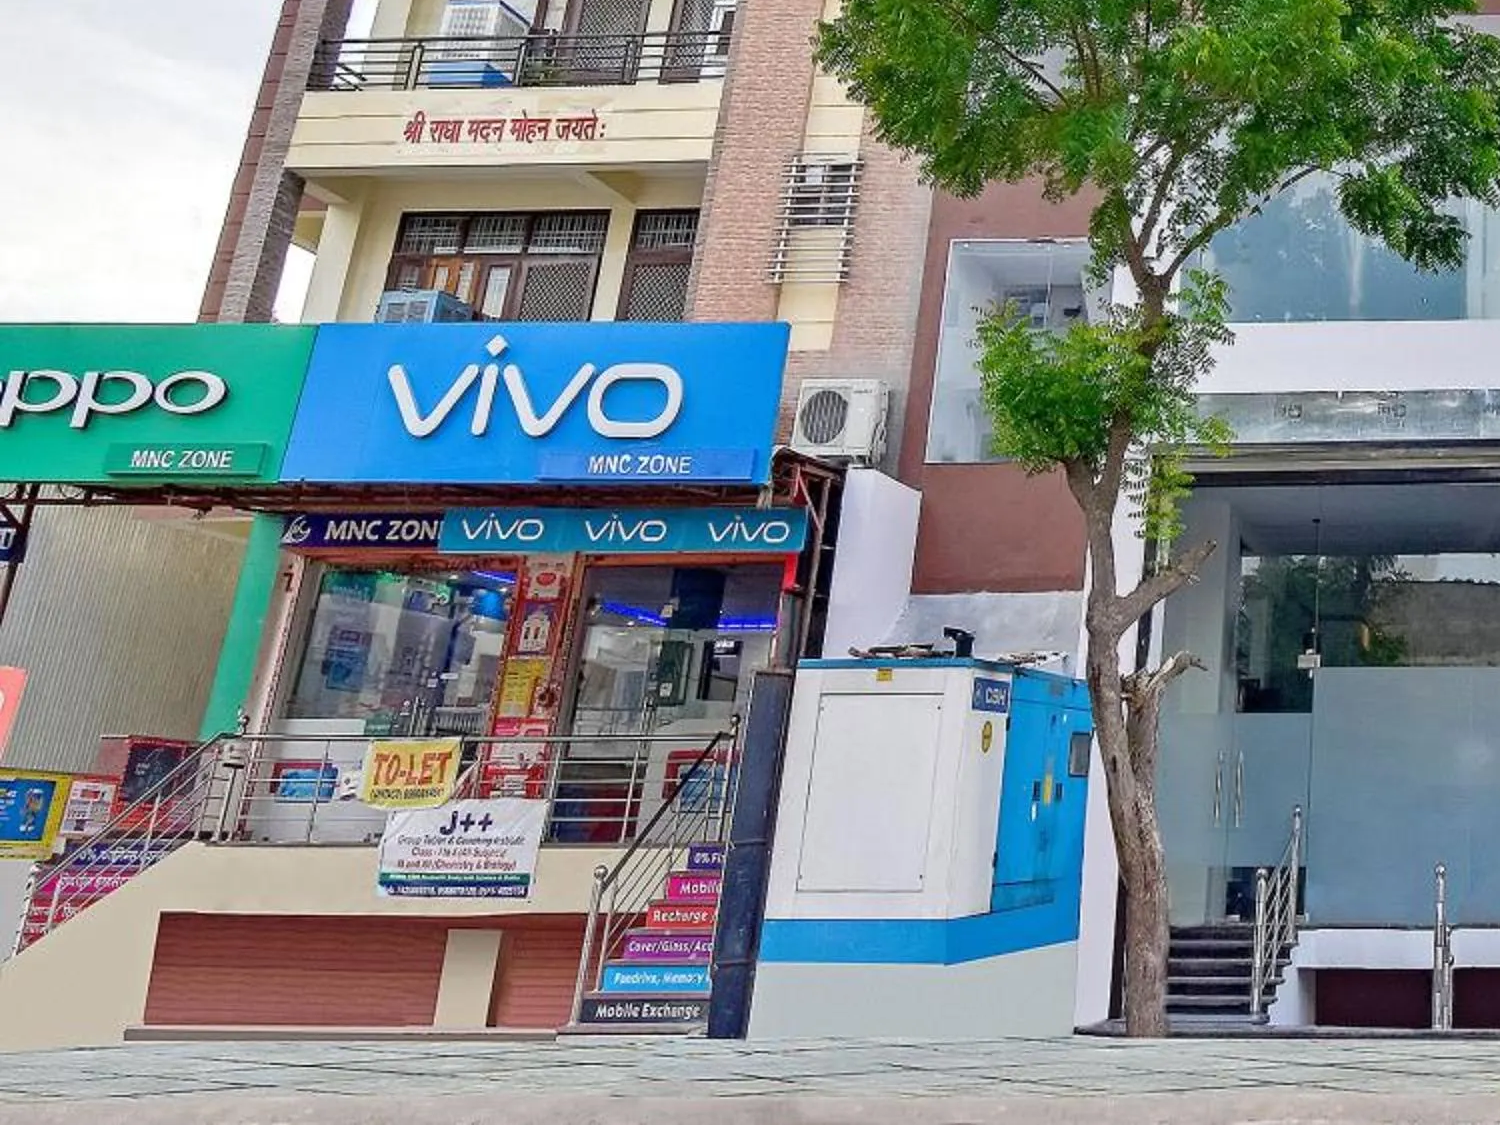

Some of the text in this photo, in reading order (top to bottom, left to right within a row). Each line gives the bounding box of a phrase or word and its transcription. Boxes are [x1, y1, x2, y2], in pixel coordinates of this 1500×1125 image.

[403, 111, 426, 144] श्री
[430, 120, 464, 144] राधा
[468, 118, 506, 143] मदन
[510, 109, 552, 143] मोहन
[0, 370, 227, 429] ppo
[130, 450, 234, 468] MNC ZONE
[588, 455, 692, 474] MNC ZONE
[323, 520, 382, 540] MNC
[373, 751, 452, 786] TO-LET
[653, 910, 709, 924] Recharge
[595, 1002, 700, 1020] Mobile Exchange
